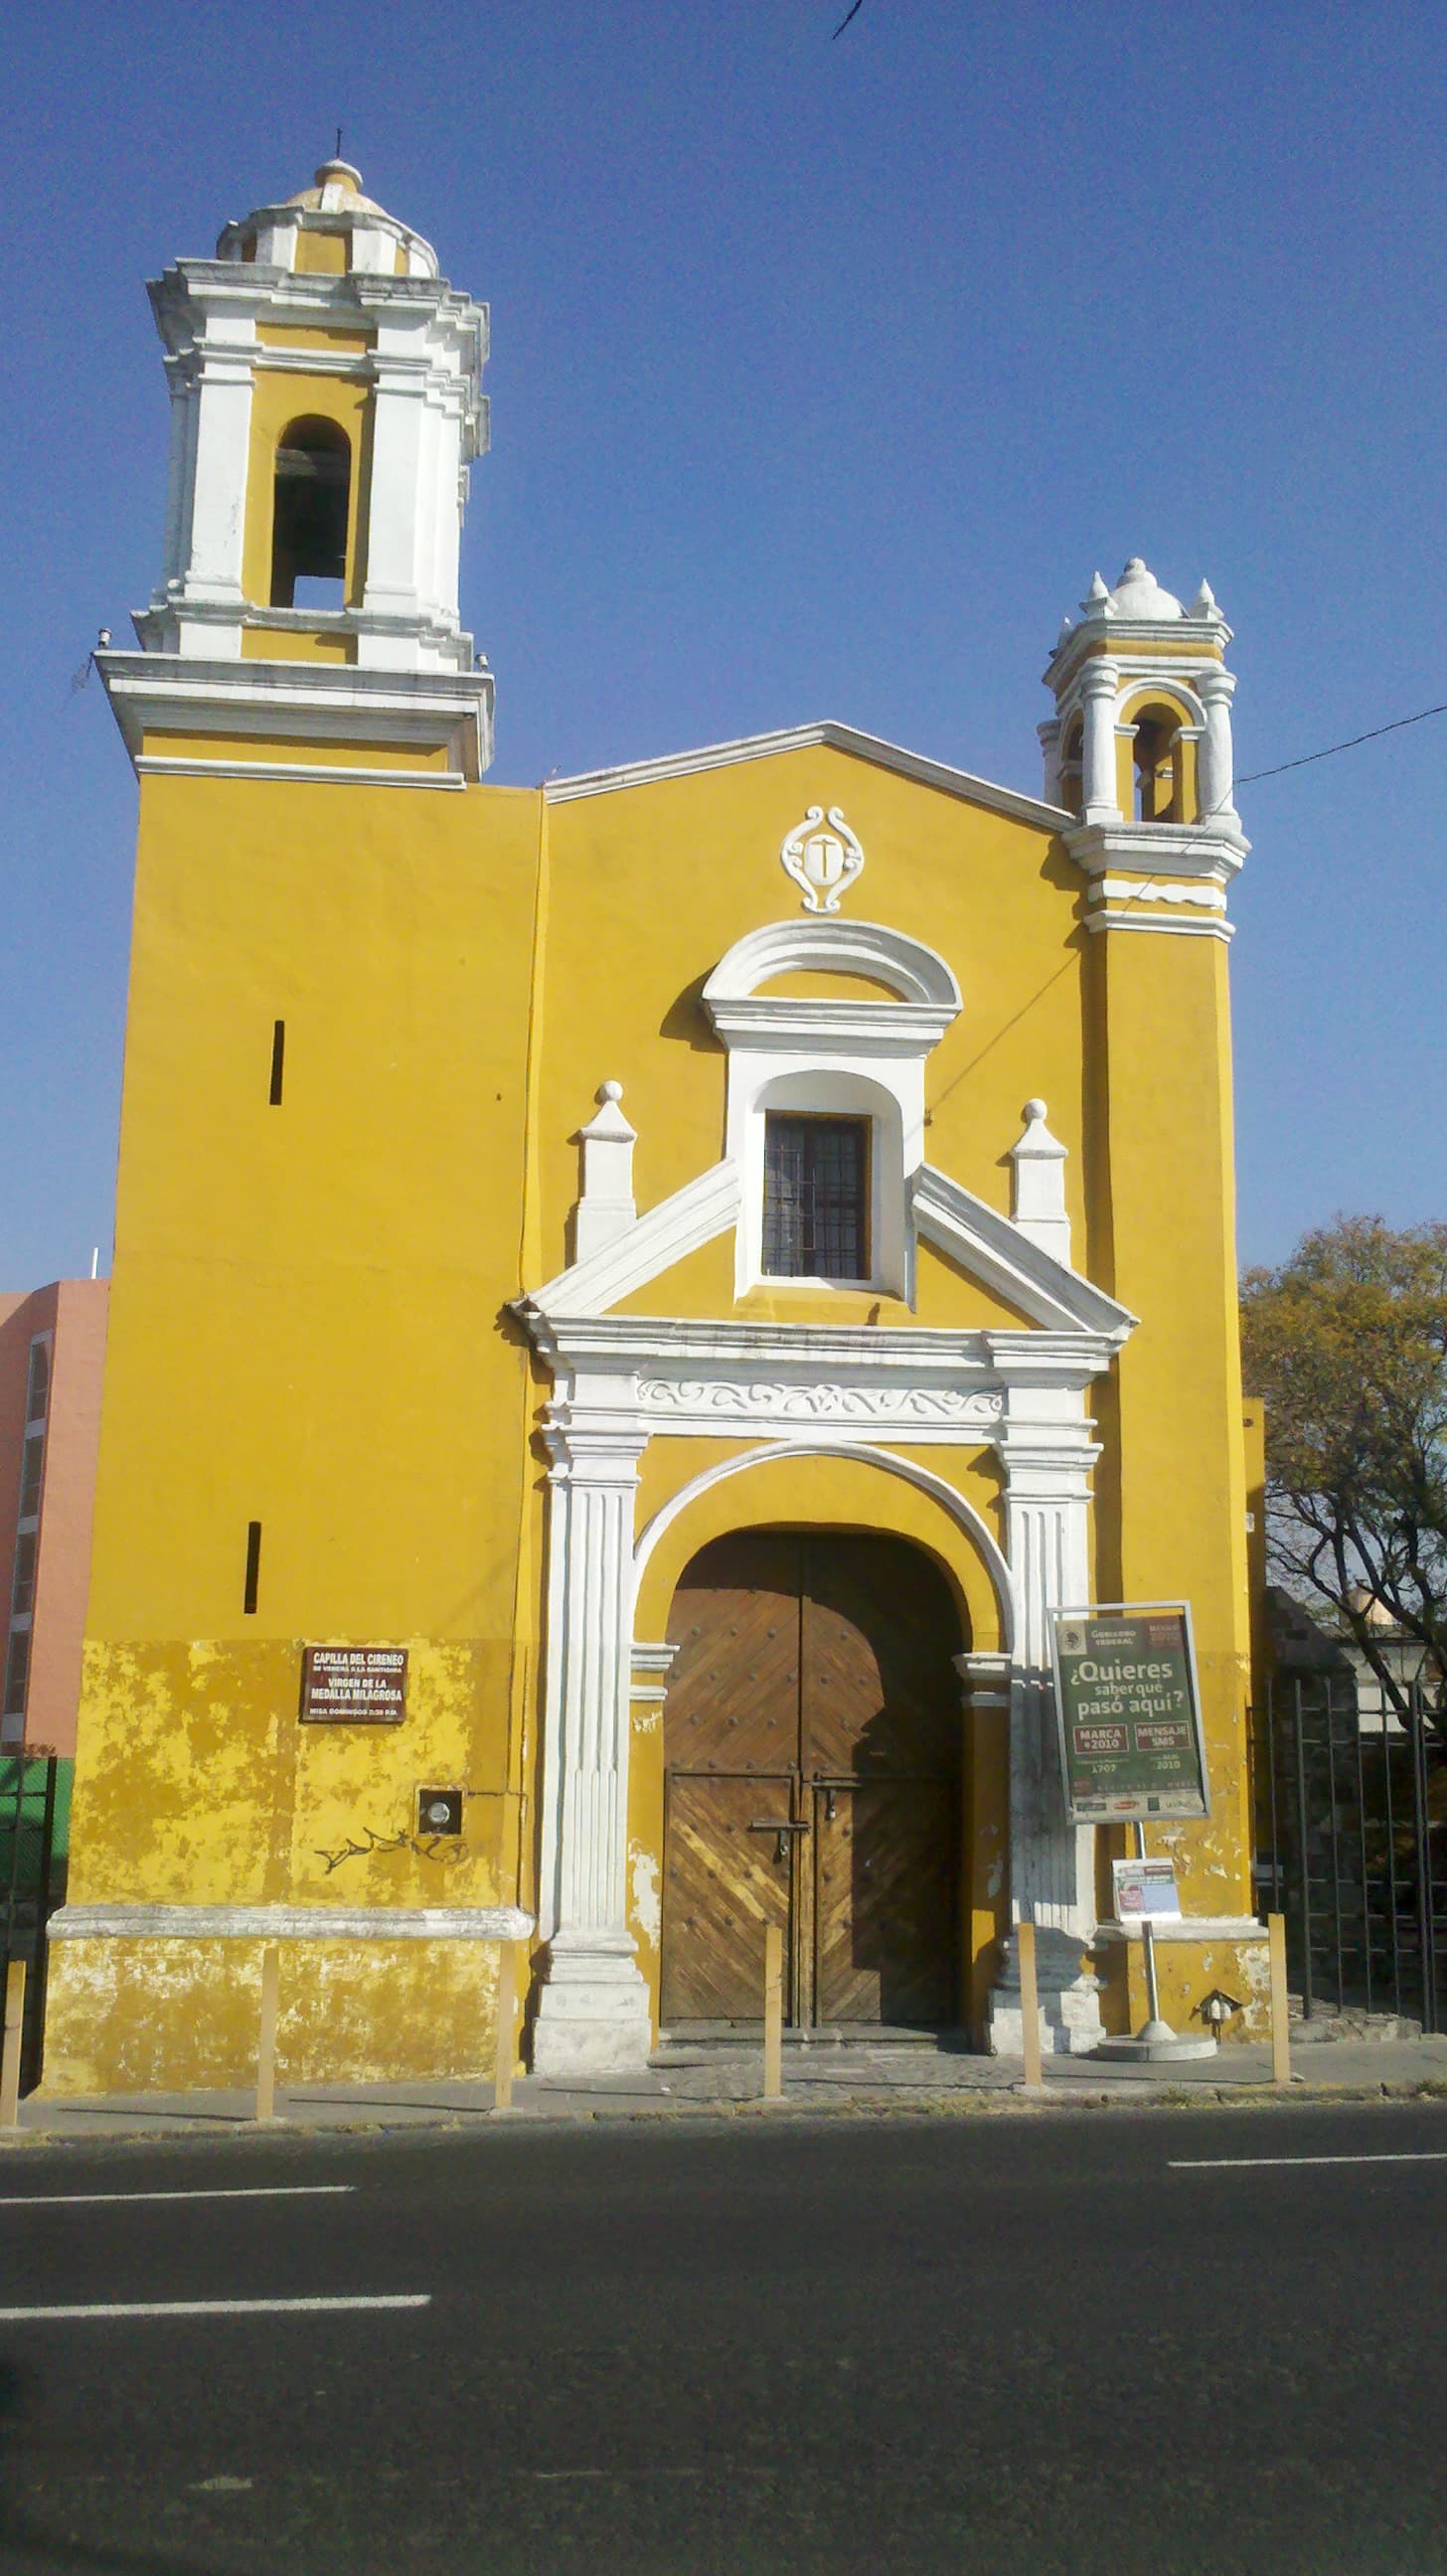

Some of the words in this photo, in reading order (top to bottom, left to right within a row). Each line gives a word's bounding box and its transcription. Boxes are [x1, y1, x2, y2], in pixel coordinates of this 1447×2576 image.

[313, 1652, 348, 1665] CAPILLA
[350, 1653, 366, 1666] DEL
[367, 1654, 404, 1667] CIRENEO
[1070, 1658, 1174, 1686] ¿Quieres
[328, 1678, 361, 1688] VIRGEN
[362, 1679, 374, 1689] DE
[375, 1679, 387, 1690] LA
[1095, 1682, 1134, 1695] saber
[1136, 1680, 1163, 1698] qué
[311, 1688, 351, 1700] MEDALLA
[352, 1689, 402, 1701] MILAGROSA
[1077, 1694, 1124, 1721] pasó
[1129, 1690, 1185, 1718] aquí?
[1079, 1729, 1122, 1739] MARCA
[1137, 1725, 1187, 1736] MENSAJE
[1151, 1736, 1175, 1746] SMS
